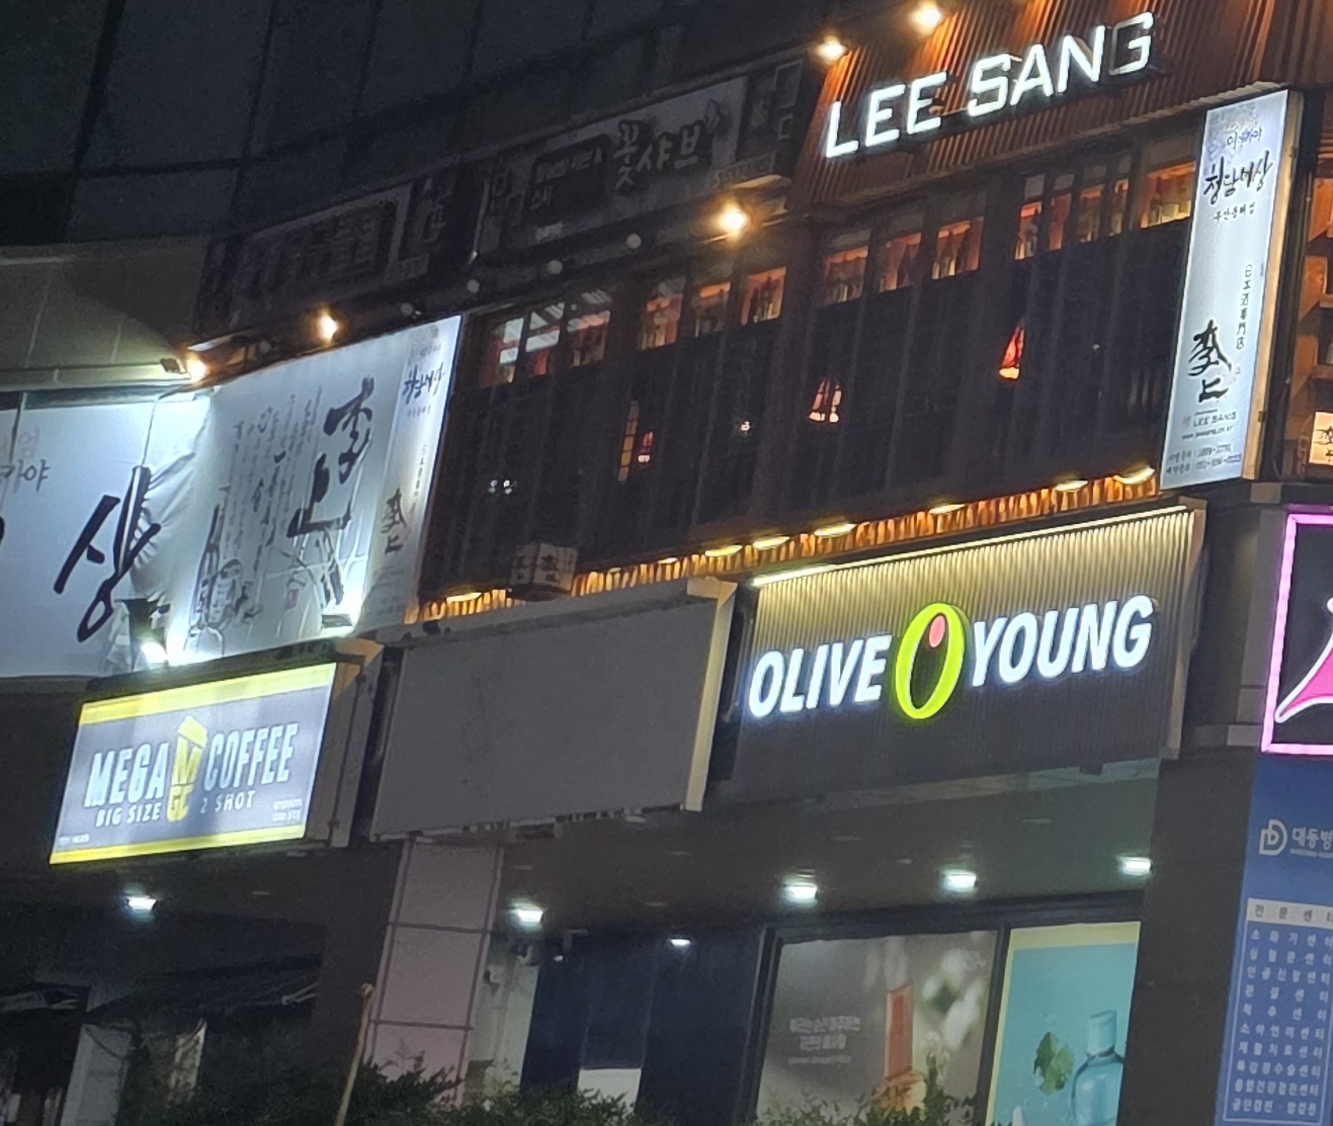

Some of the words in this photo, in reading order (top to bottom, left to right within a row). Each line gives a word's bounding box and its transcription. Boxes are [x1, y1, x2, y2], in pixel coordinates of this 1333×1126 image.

[825, 70, 949, 159] LEE
[967, 11, 1155, 119] SANG
[748, 632, 892, 720] OLIVE
[969, 595, 1155, 689] YOUNG
[84, 741, 170, 808] MEGA
[204, 723, 299, 792] COFFEE
[96, 808, 122, 828] BIG
[127, 802, 162, 825] SIZE
[214, 789, 256, 812] SHOT
